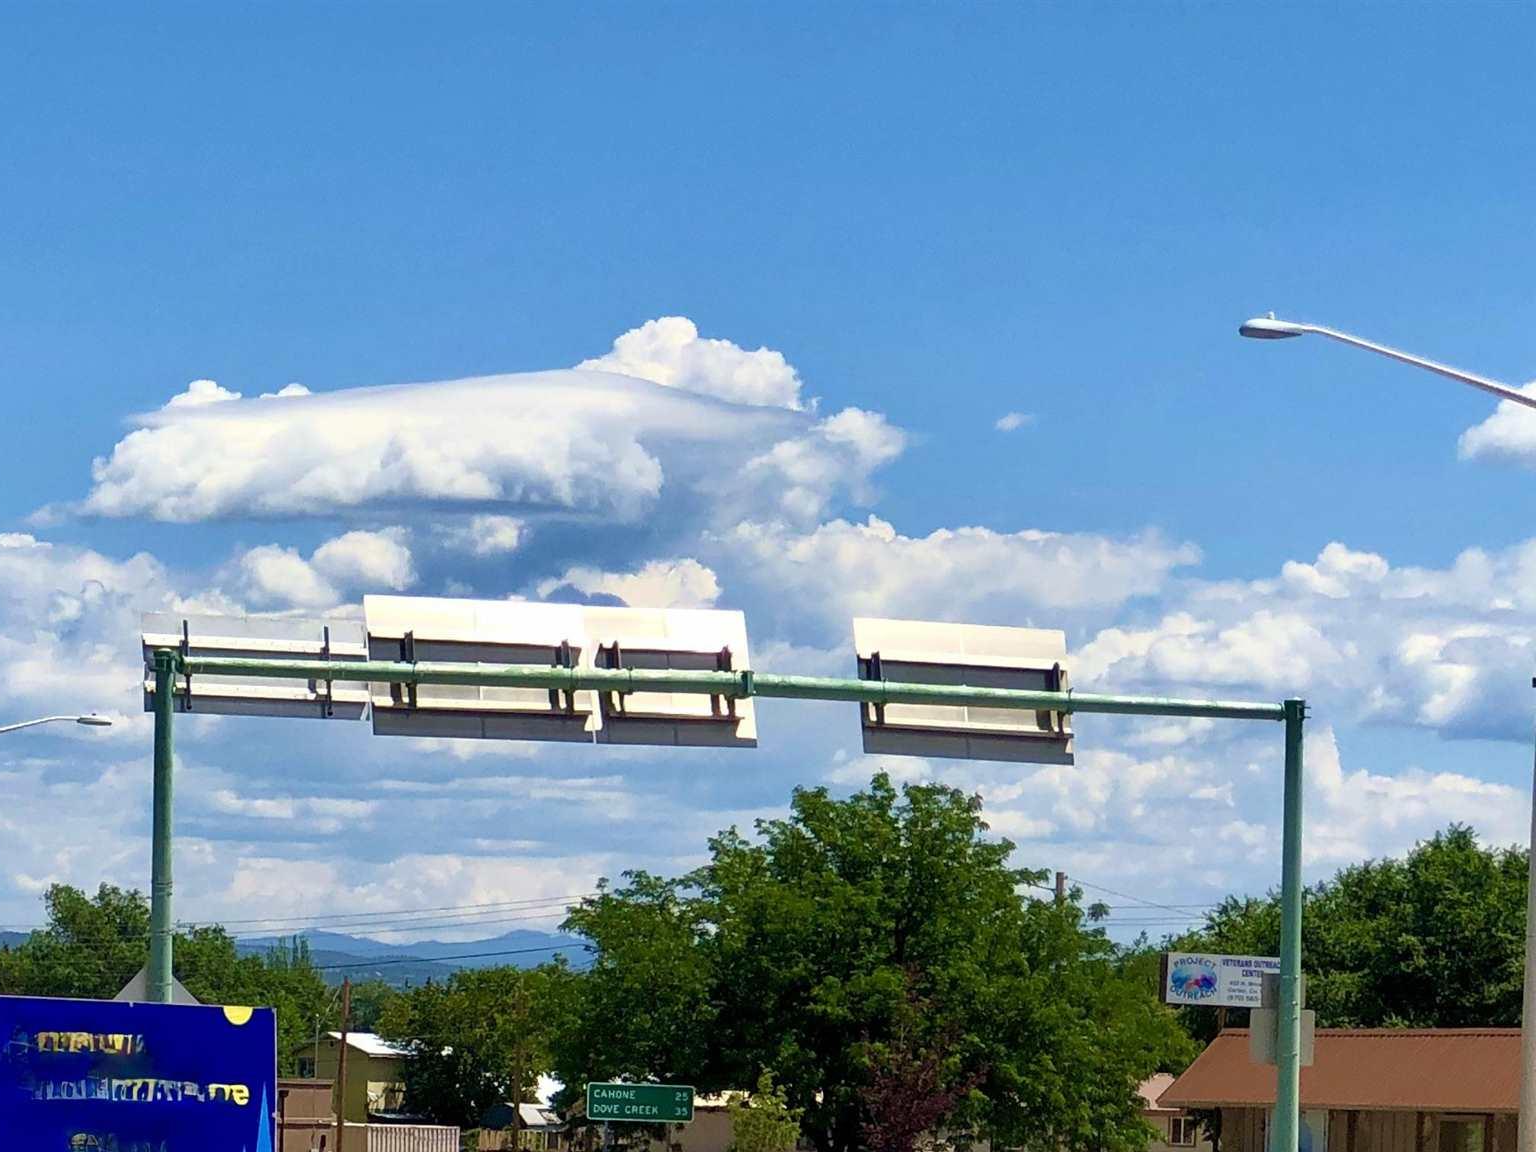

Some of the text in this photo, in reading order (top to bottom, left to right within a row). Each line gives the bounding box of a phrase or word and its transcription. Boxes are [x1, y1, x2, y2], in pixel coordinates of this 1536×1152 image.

[1174, 956, 1217, 969] PROJECT
[1221, 959, 1252, 968] VETERANS
[1169, 984, 1218, 1000] OUTREACH
[593, 1089, 689, 1101] CAHONE 25
[593, 1104, 688, 1116] DOVE CREEK 35
